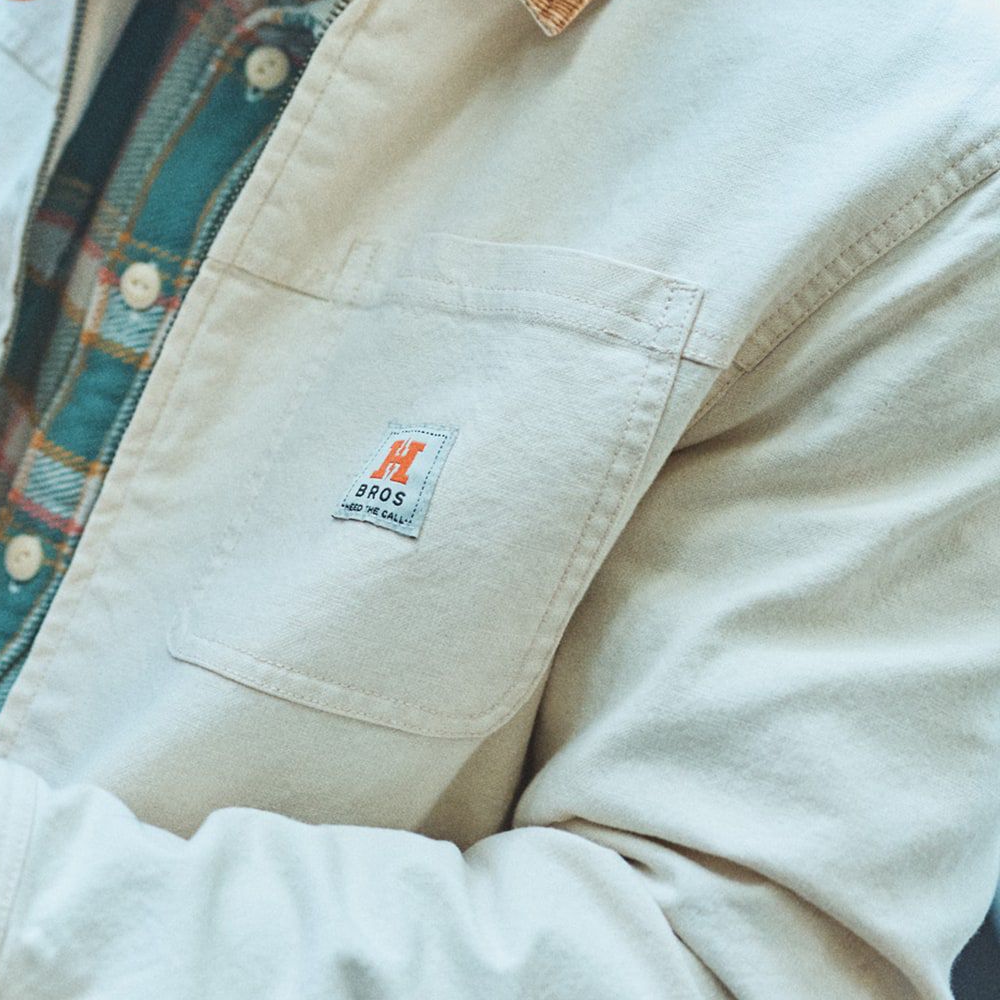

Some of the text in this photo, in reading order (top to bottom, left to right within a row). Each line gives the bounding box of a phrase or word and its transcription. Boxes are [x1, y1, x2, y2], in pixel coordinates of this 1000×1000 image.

[369, 438, 427, 485] H
[354, 483, 406, 507] BROS
[381, 509, 404, 525] CALL
